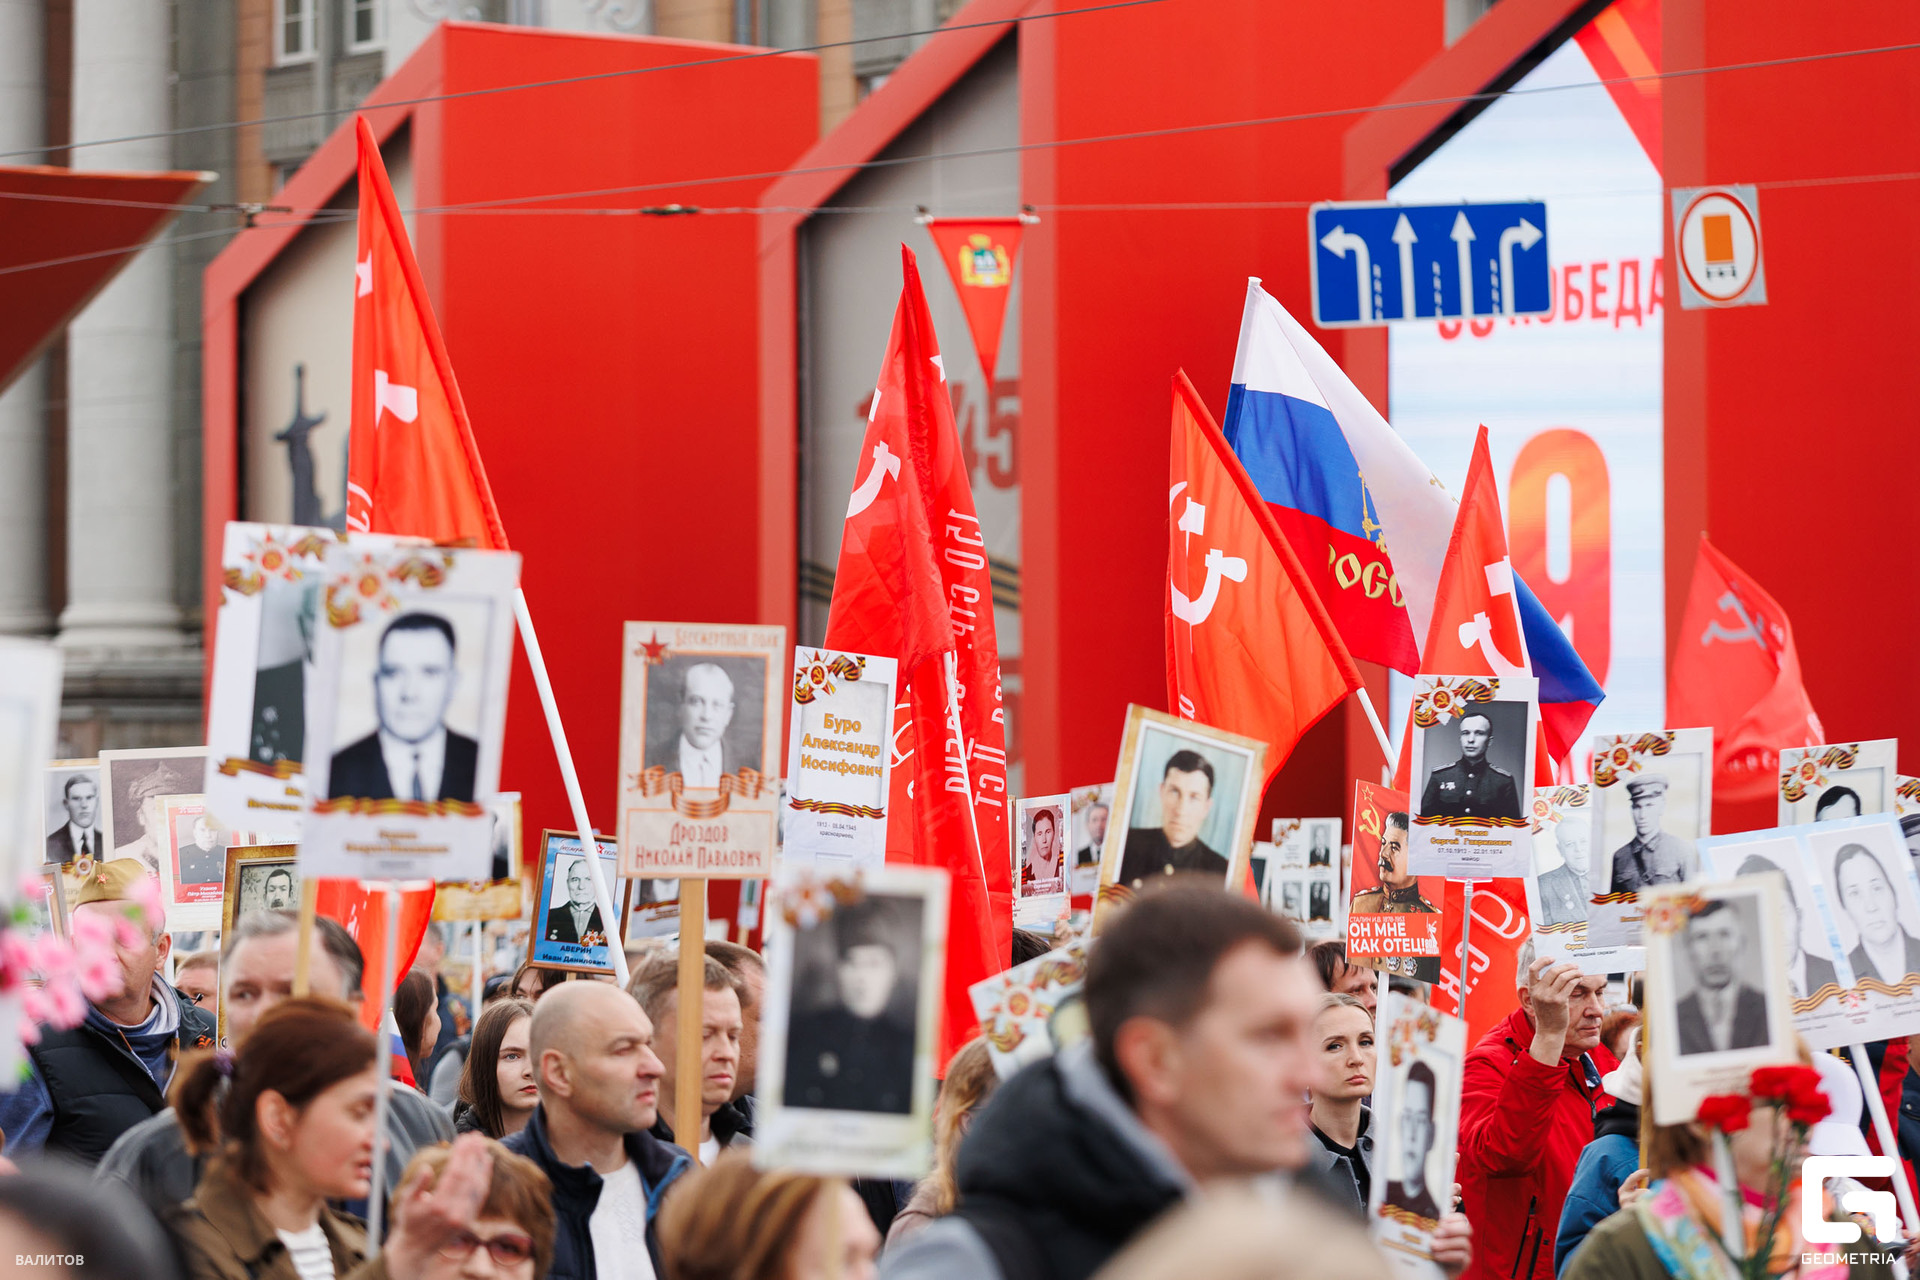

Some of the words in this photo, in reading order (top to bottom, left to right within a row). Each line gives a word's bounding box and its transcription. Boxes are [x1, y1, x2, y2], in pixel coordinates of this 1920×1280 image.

[823, 713, 862, 735] Буро
[801, 733, 881, 759] Александр
[800, 754, 884, 779] Иосифович
[1349, 922, 1371, 937] ОН
[1374, 922, 1407, 937] МНЕ
[560, 945, 592, 954] АВЕРИН
[1350, 938, 1380, 953] КАК
[1383, 937, 1425, 955] ОТЕЦ!
[542, 953, 562, 961] Иван
[563, 956, 606, 965] Данилович
